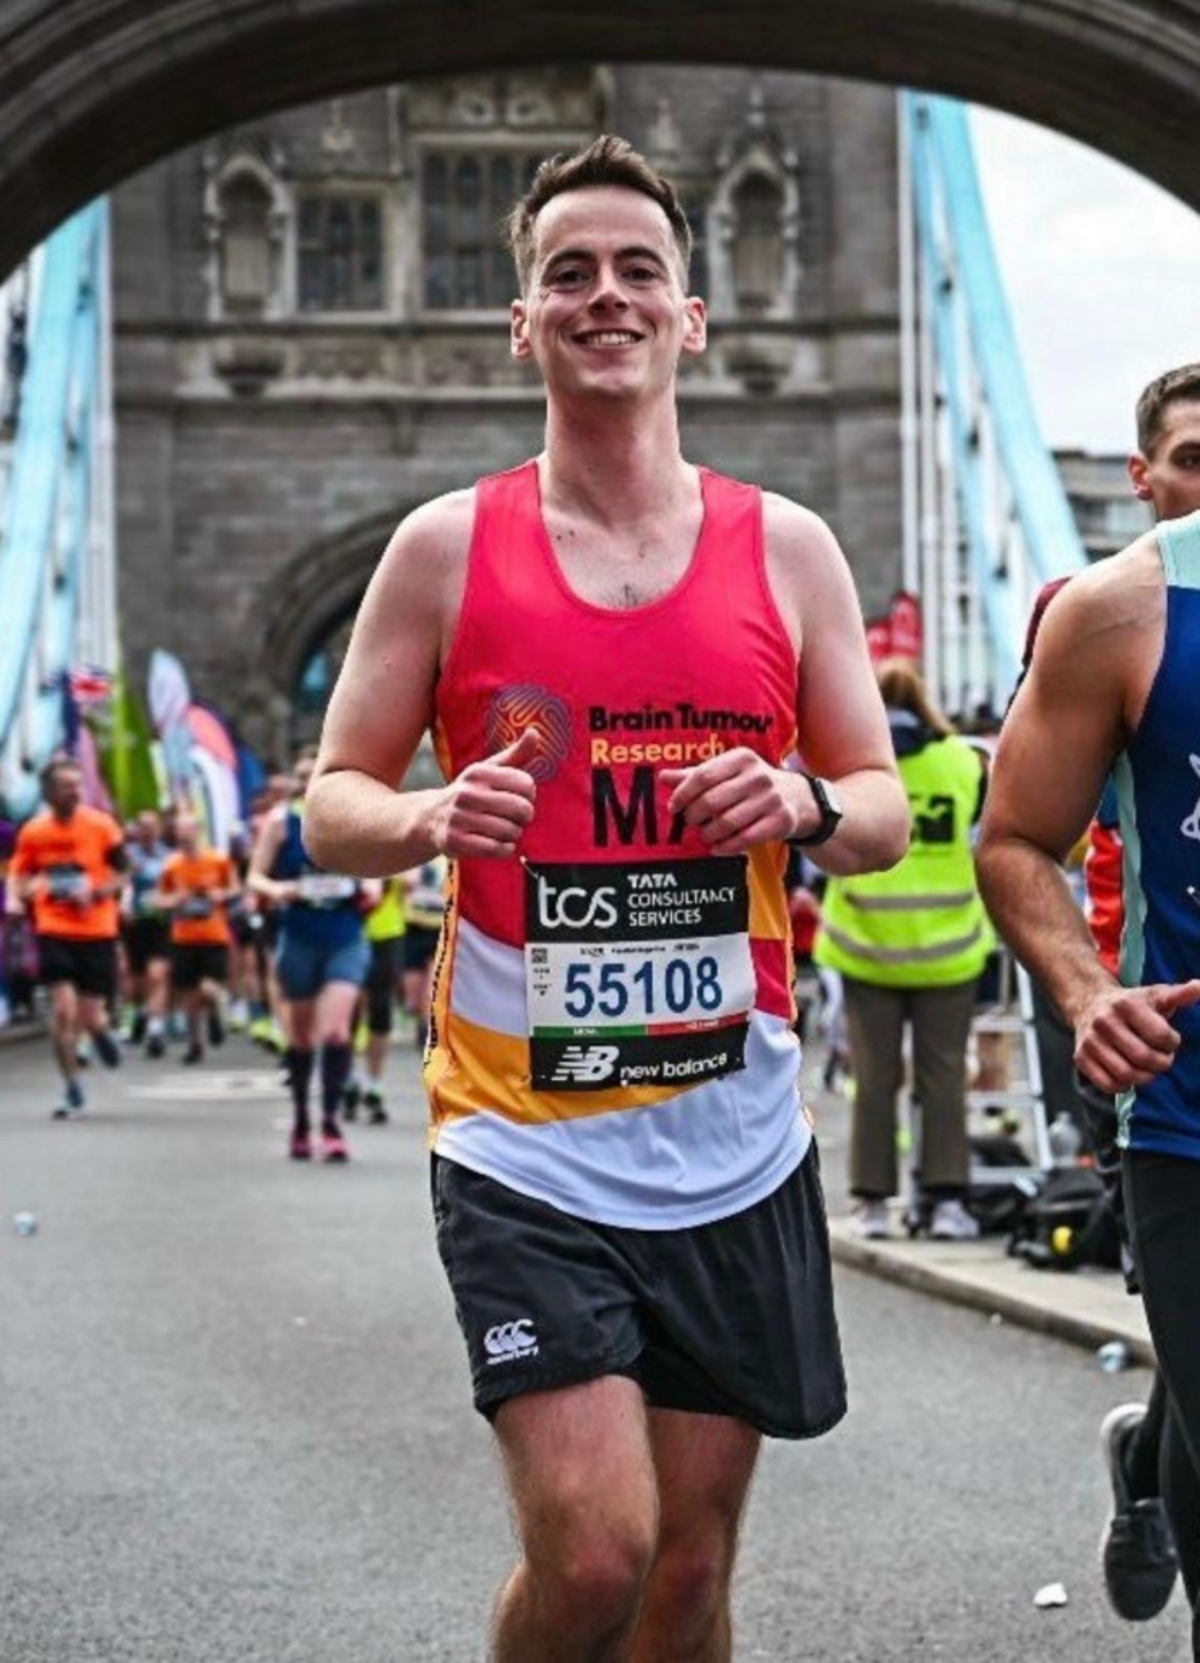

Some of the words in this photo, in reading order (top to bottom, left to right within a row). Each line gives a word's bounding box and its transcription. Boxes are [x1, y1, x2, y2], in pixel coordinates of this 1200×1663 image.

[589, 704, 673, 731] Brain
[591, 733, 724, 765] Research
[591, 766, 686, 847] M
[627, 873, 678, 889] TATA
[538, 876, 618, 929] tcs
[627, 886, 736, 909] CONSULTANCY
[628, 907, 702, 927] SERVICES
[564, 956, 723, 1018] 55108
[620, 1064, 659, 1079] new
[663, 1052, 727, 1078] balance
